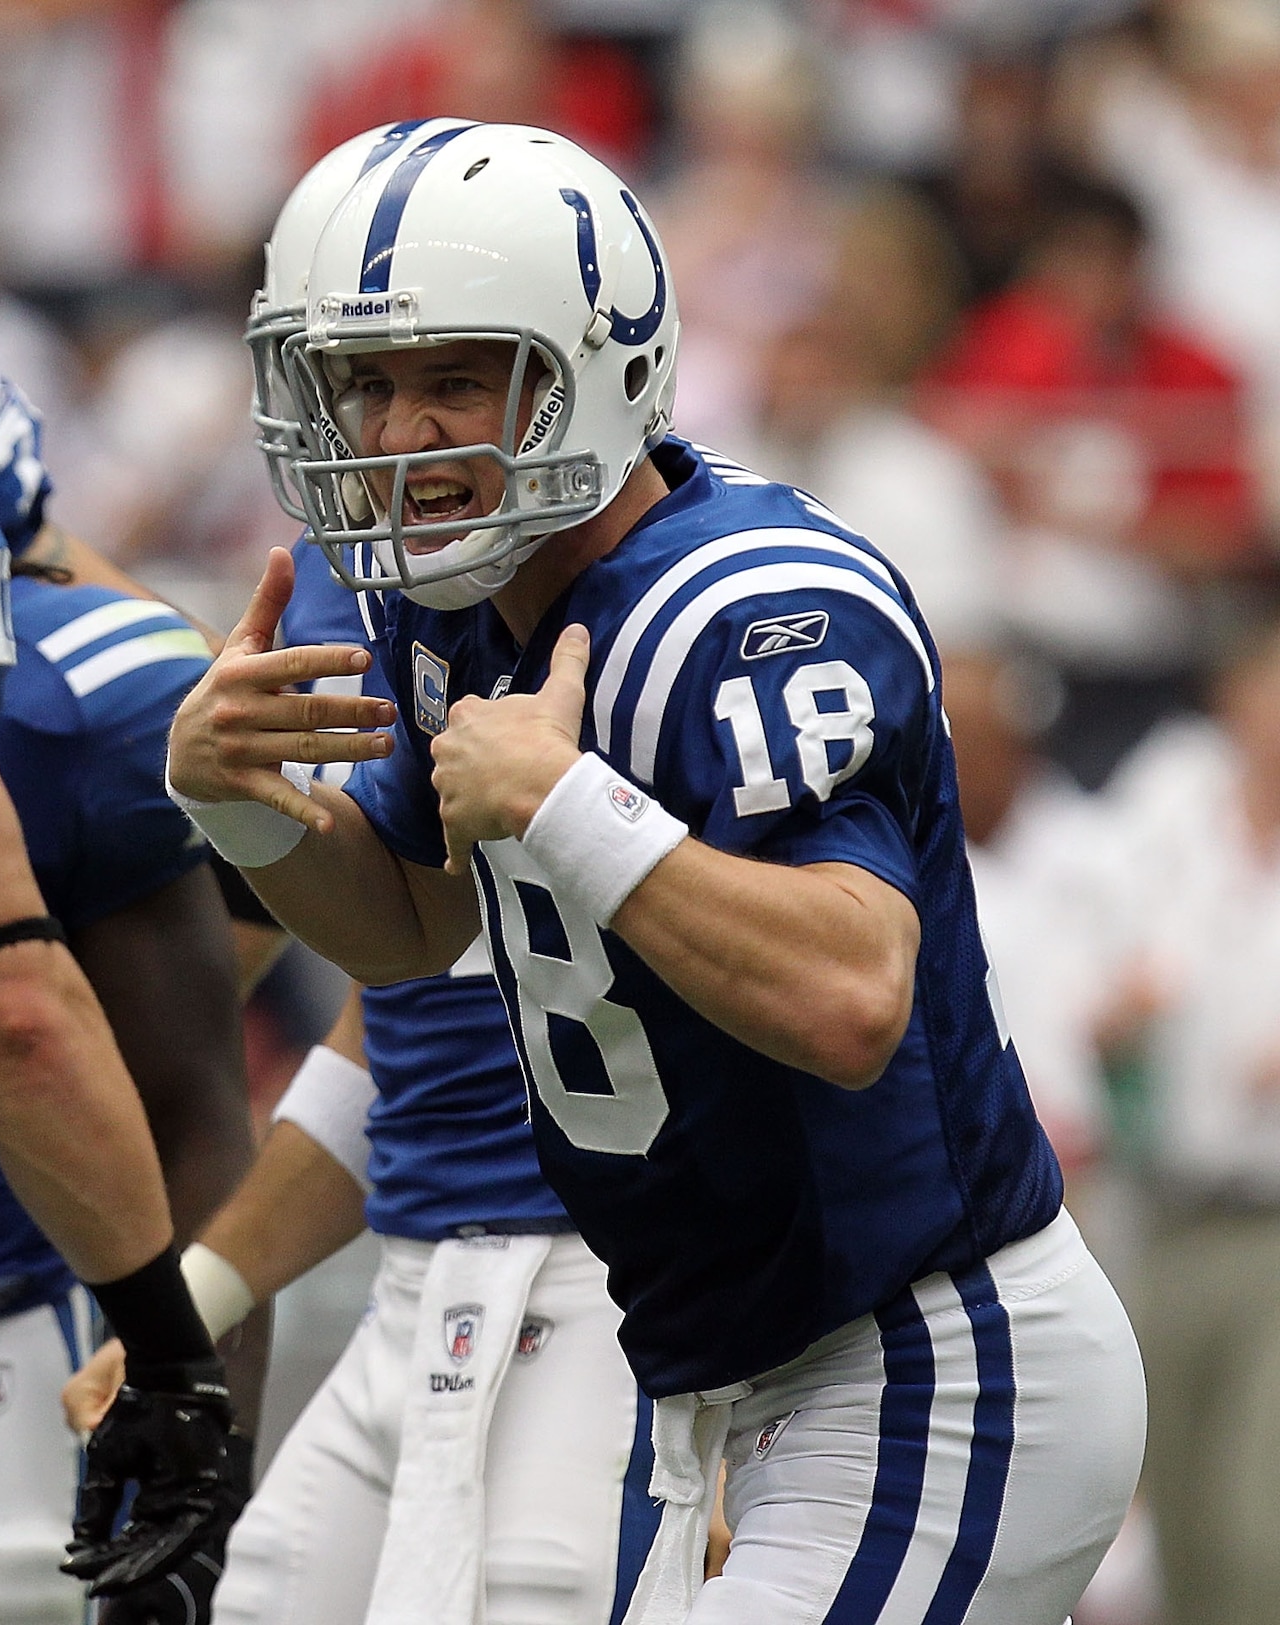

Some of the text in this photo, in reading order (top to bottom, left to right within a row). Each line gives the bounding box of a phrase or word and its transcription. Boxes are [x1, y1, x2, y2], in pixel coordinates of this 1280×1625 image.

[341, 300, 394, 317] Riddel
[521, 385, 566, 454] Riddell
[713, 659, 876, 818] 18
